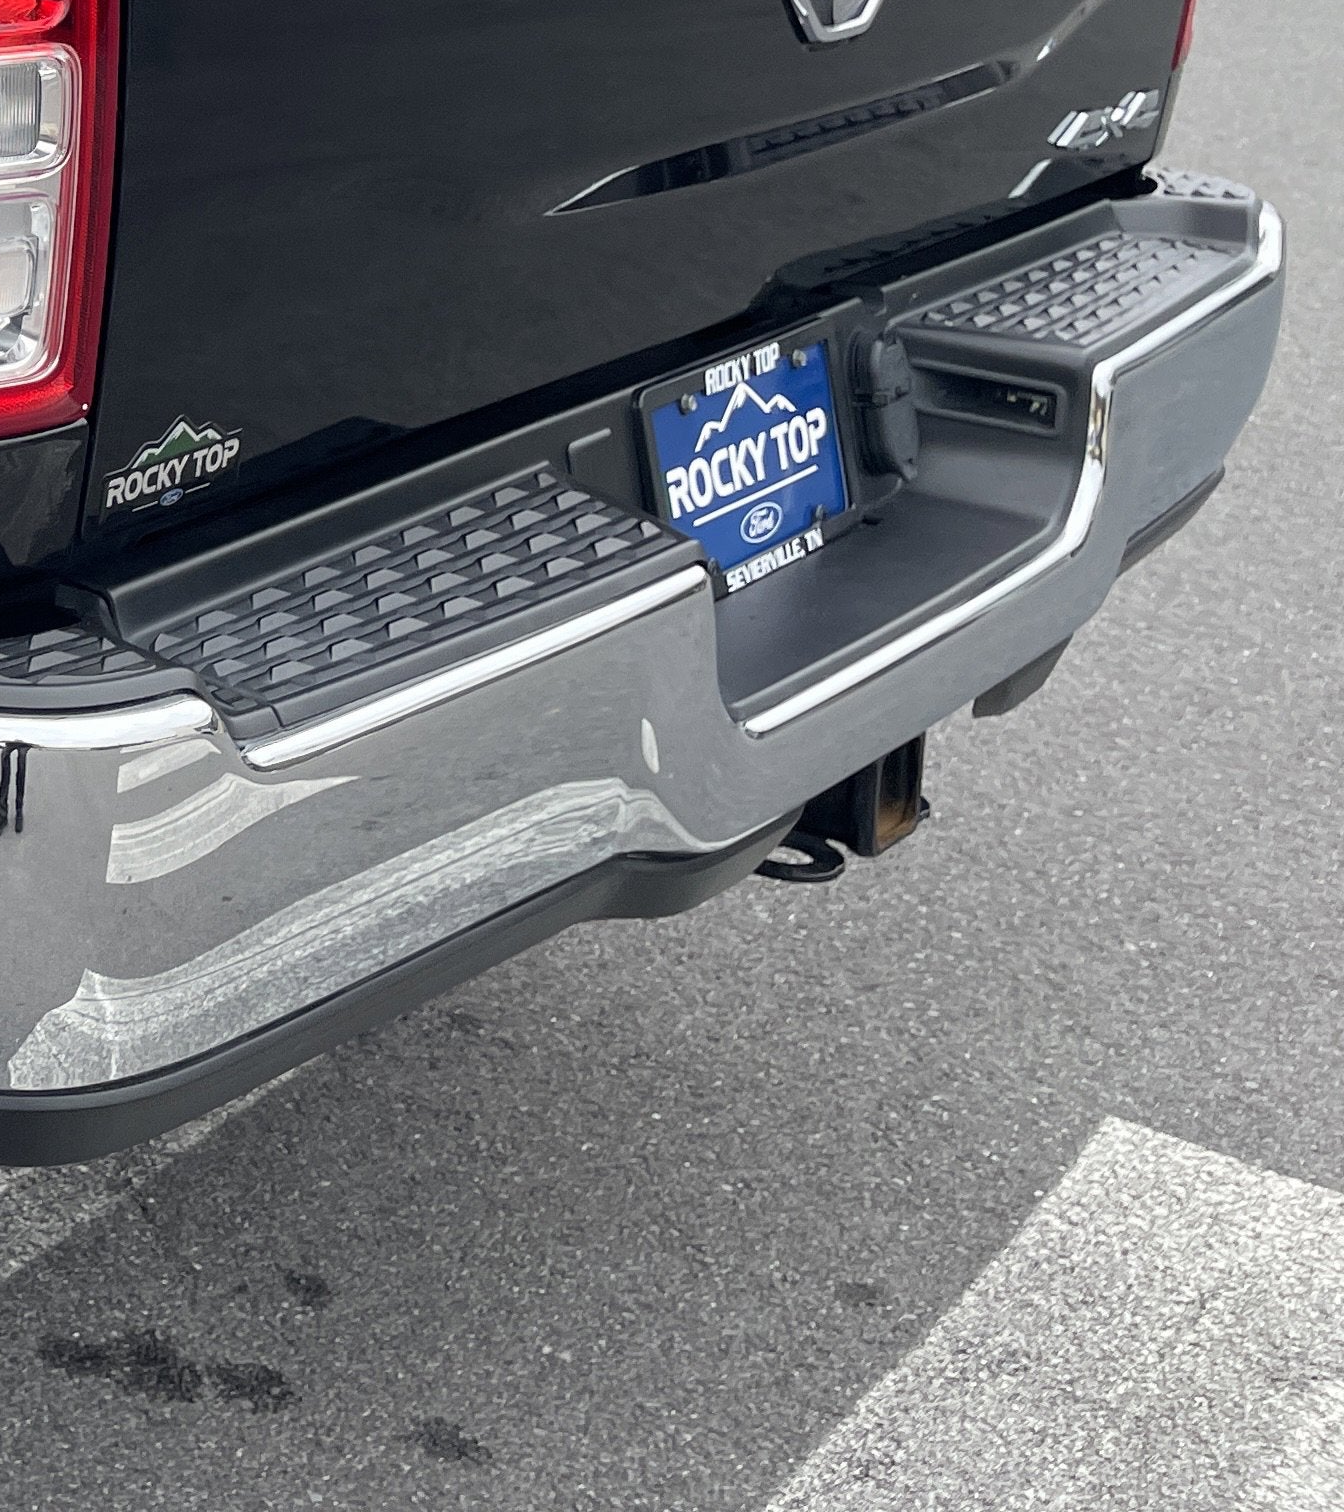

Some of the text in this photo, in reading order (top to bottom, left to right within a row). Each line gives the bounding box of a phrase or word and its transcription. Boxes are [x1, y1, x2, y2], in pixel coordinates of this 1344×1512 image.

[752, 342, 780, 375] TOP
[105, 438, 240, 508] ROCKY TOP
[666, 407, 827, 518] ROCKY TOP
